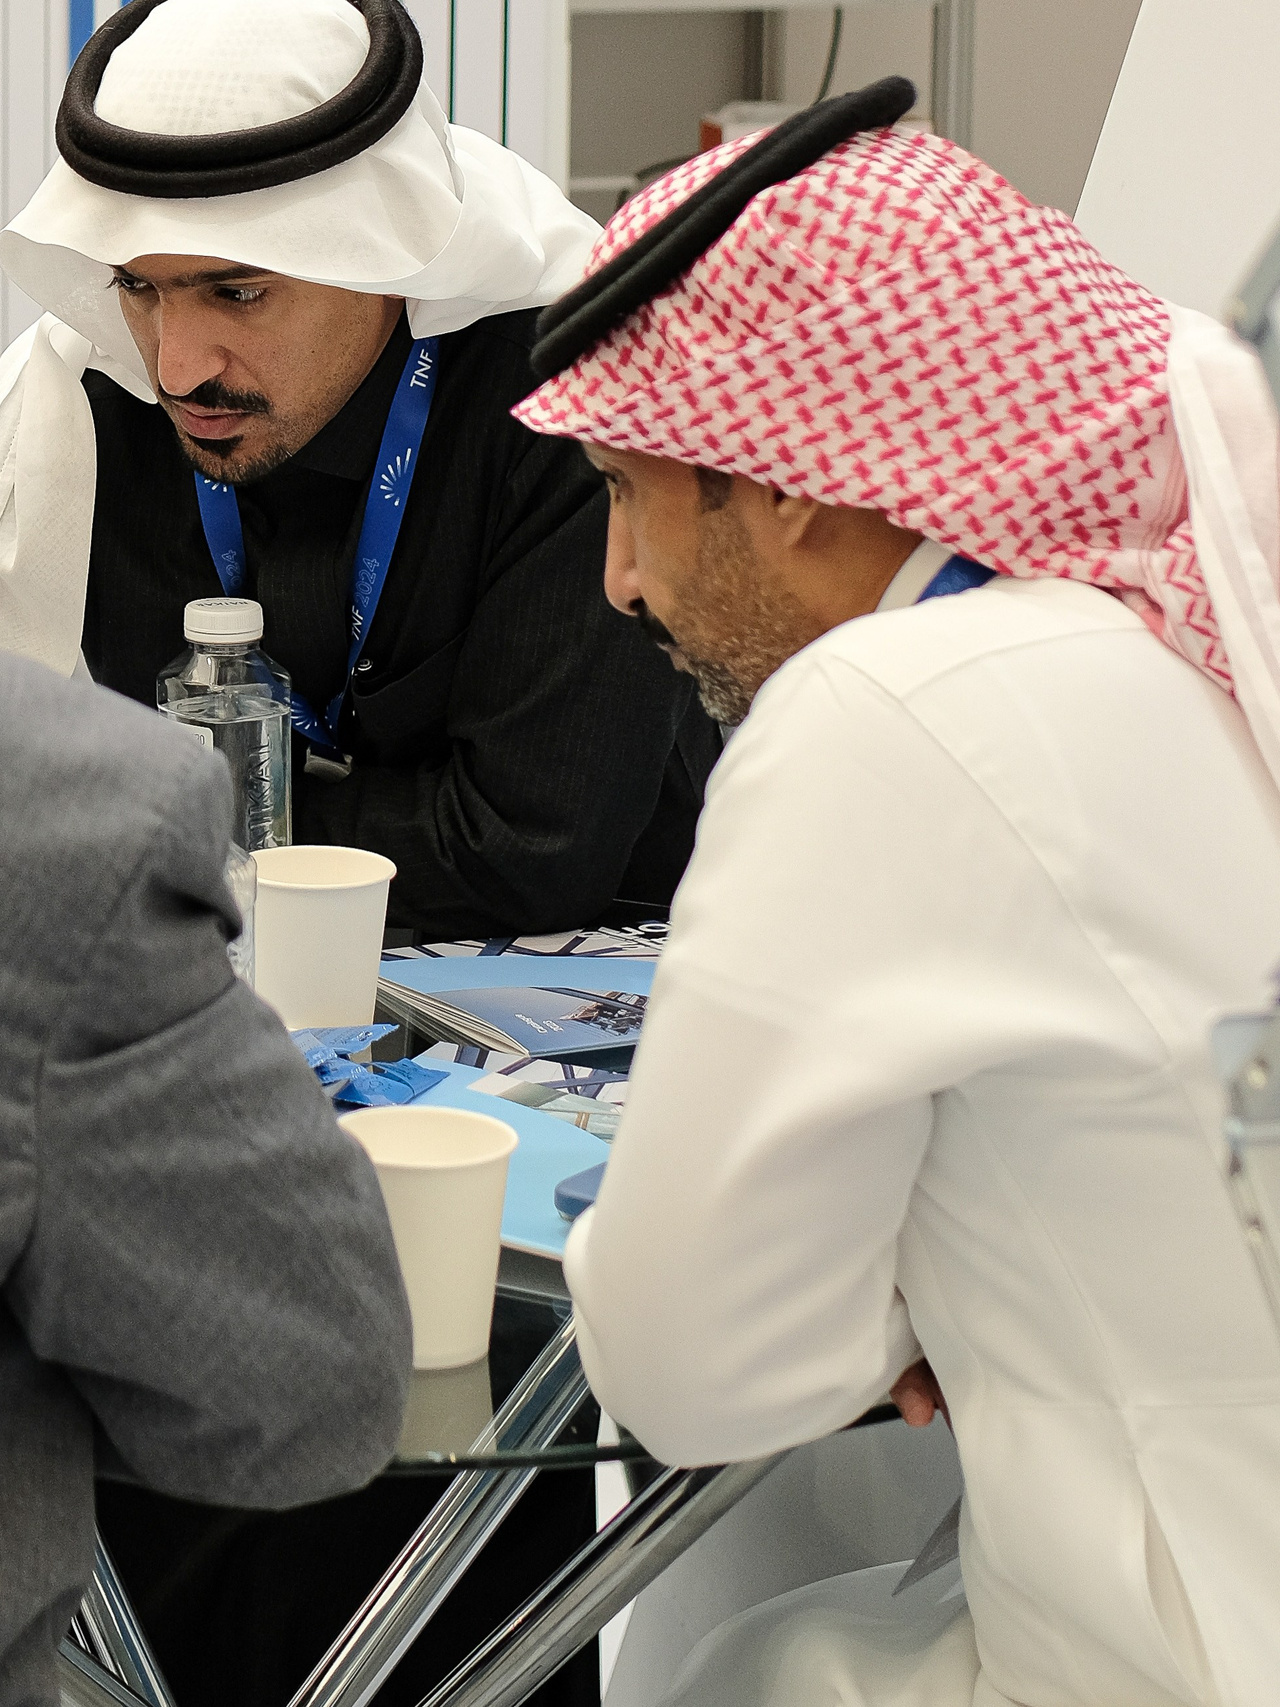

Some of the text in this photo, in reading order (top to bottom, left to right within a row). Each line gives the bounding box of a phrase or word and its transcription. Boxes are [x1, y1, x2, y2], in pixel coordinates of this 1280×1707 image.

[410, 348, 433, 388] TNF
[221, 549, 241, 590] 024
[352, 557, 380, 641] TNF 2024
[247, 734, 276, 851] AIKAL
